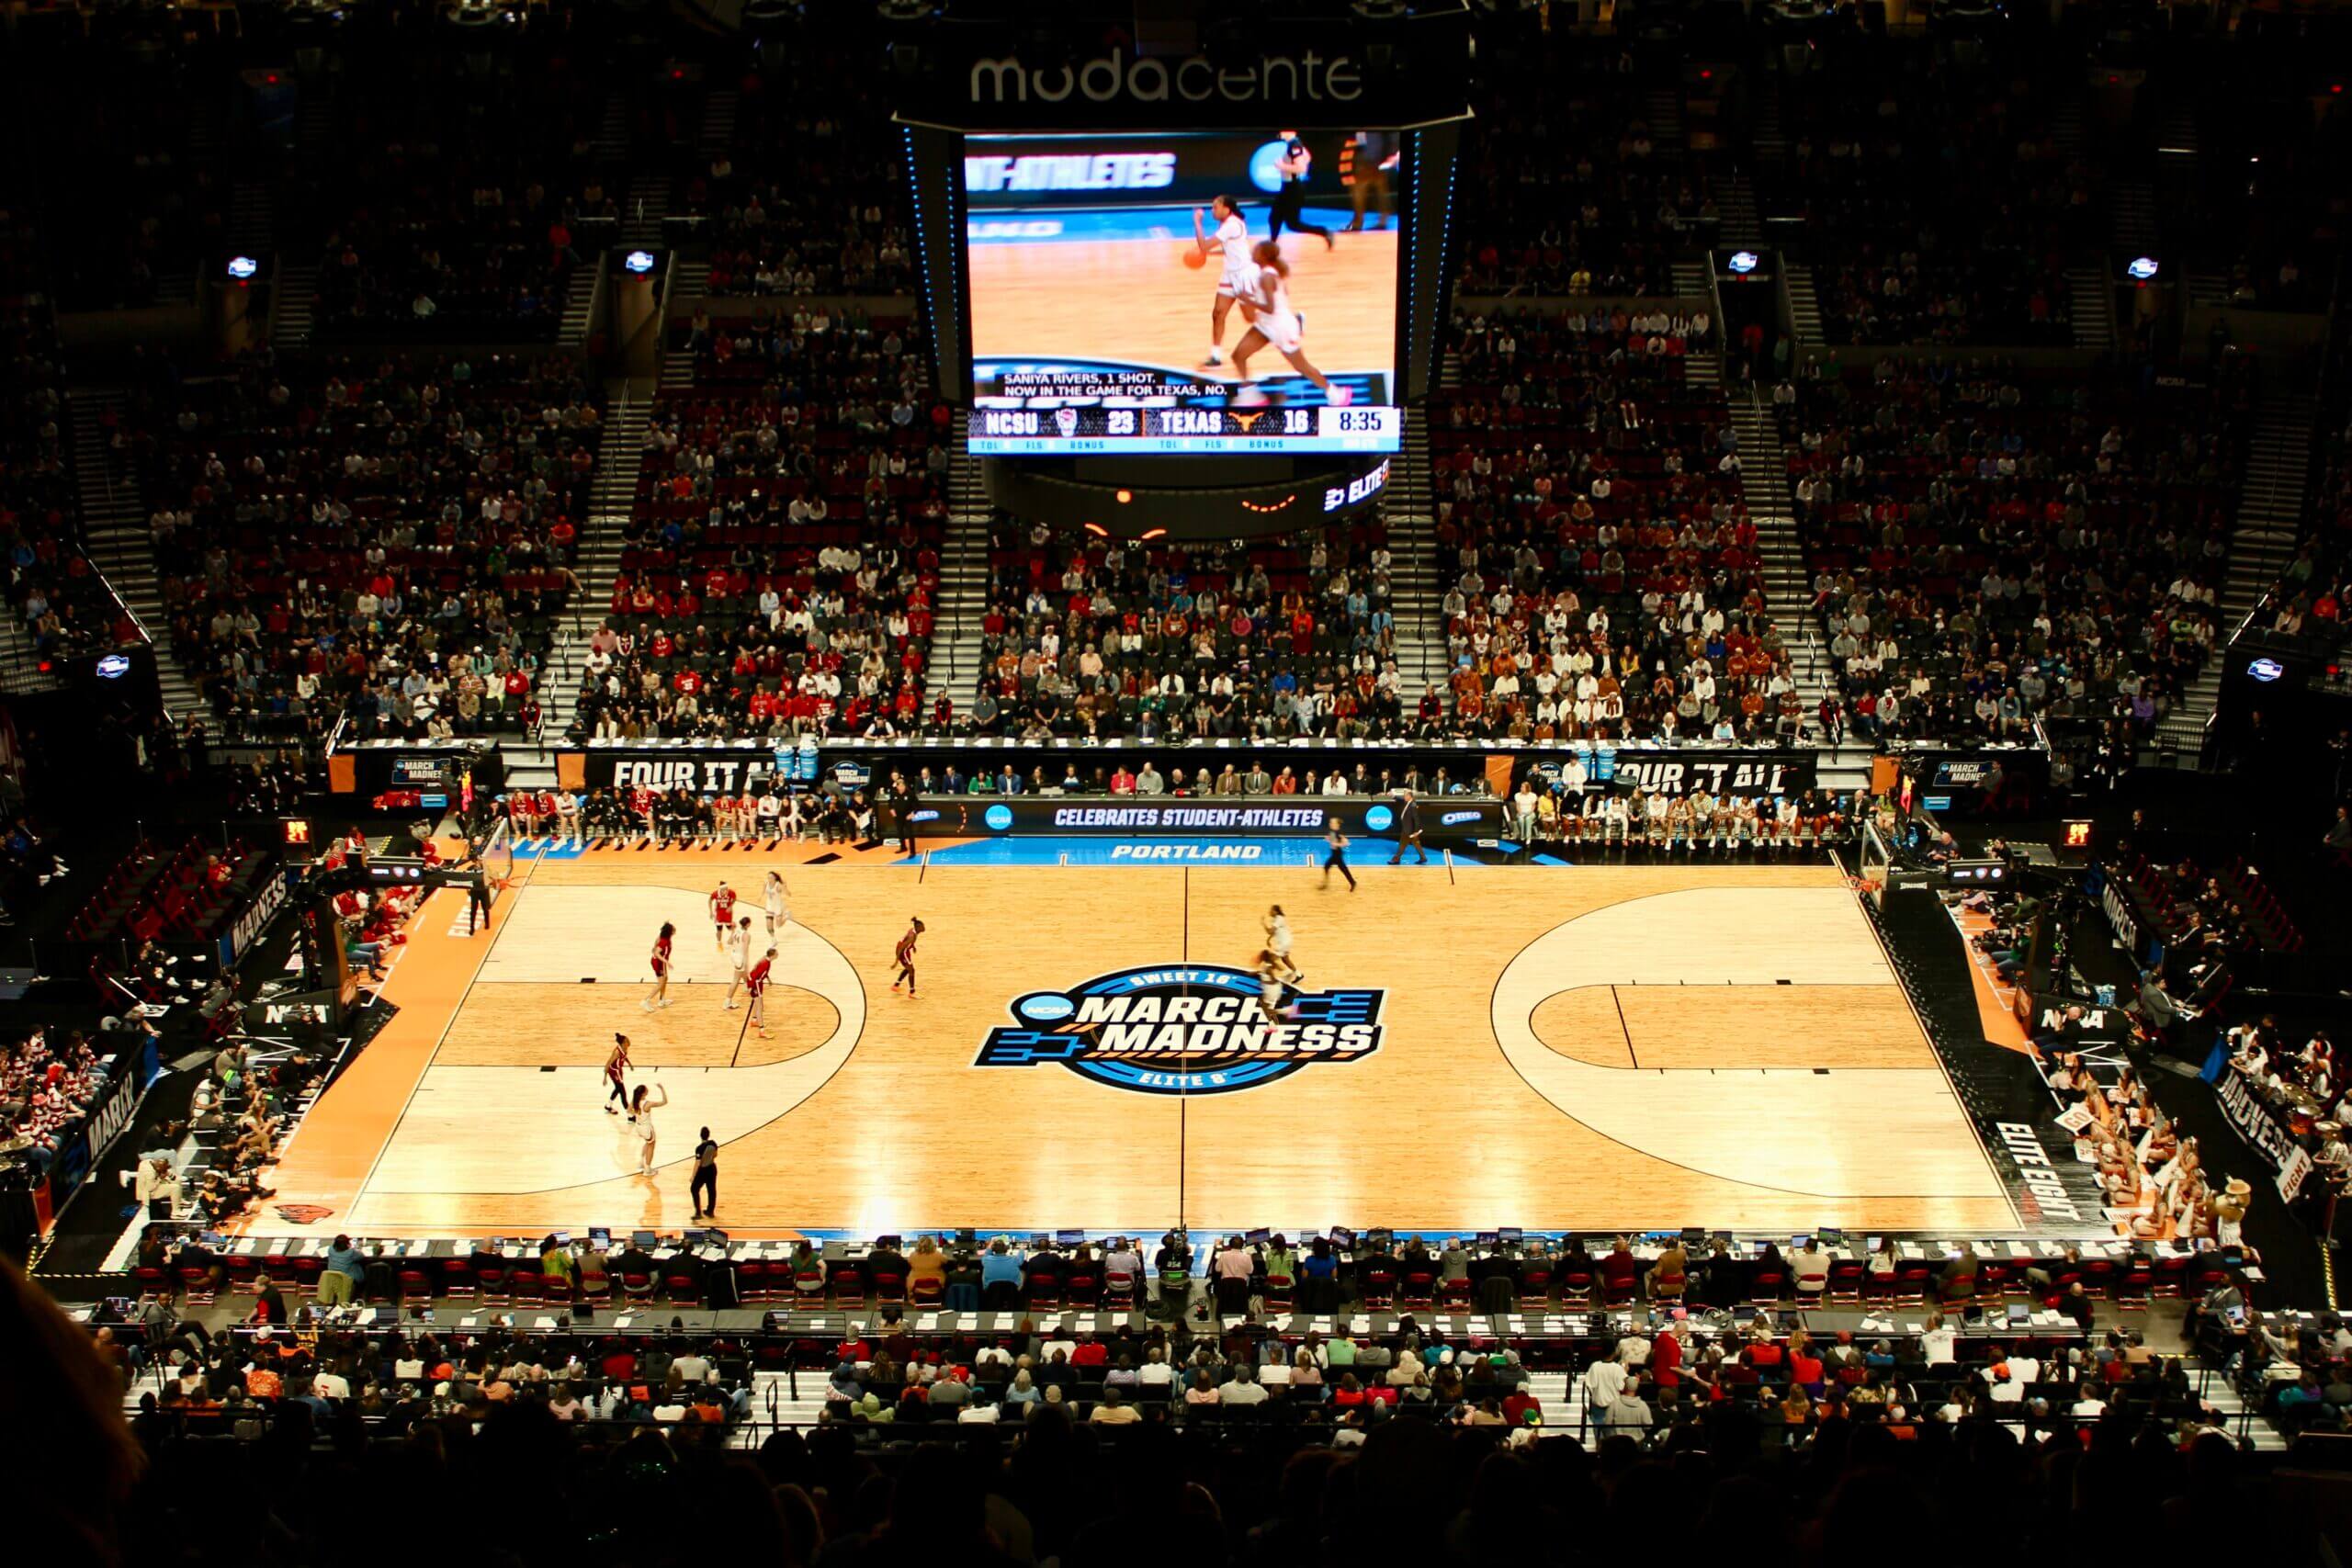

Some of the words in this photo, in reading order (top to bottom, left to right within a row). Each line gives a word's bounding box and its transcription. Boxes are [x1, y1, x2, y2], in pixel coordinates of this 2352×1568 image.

[1004, 374, 1049, 384] SANIYA
[1053, 374, 1102, 385] RIVERS,
[1107, 374, 1114, 384] 1
[1119, 373, 1156, 384] SHOT.
[1004, 386, 1036, 396] NOW
[1040, 386, 1054, 396] IN
[1057, 386, 1082, 396] THE
[1086, 386, 1124, 396] GAME
[1127, 386, 1153, 395] FOR
[1156, 385, 1201, 396] TEXAS,
[1204, 385, 1227, 395] NO.
[986, 412, 1038, 434] NCSU
[1108, 411, 1135, 434] 23
[1160, 411, 1222, 434] TEXAS
[1284, 410, 1309, 433] 16
[1340, 412, 1382, 431] 8:35
[1070, 440, 1104, 449] BONUS
[1250, 439, 1283, 448] BONUS
[1348, 466, 1383, 503] ELITE
[404, 761, 435, 770] MARCH
[1949, 764, 1980, 773] MARCH
[409, 771, 442, 779] MADNES
[614, 761, 695, 791] FOUR
[703, 761, 739, 791] IT
[1613, 763, 1684, 793] OUR
[1951, 773, 1986, 781] MADNE
[1055, 808, 1158, 827] CELEBRATES
[1161, 809, 1323, 827] STUDENT-ATHLETES
[1111, 845, 1262, 860] PORTLAND
[1129, 971, 1199, 986] SWEET
[1204, 972, 1231, 984] 16
[1075, 997, 1269, 1022] MARCH
[1097, 1024, 1376, 1051] MADNESS
[1138, 1073, 1204, 1086] ELITE
[1210, 1073, 1227, 1084] 8
[2064, 1111, 2089, 1128] GO
[1996, 1122, 2052, 1167] ELITE
[2281, 1156, 2308, 1199] FIGHT
[2020, 1168, 2082, 1221] EIGHT
